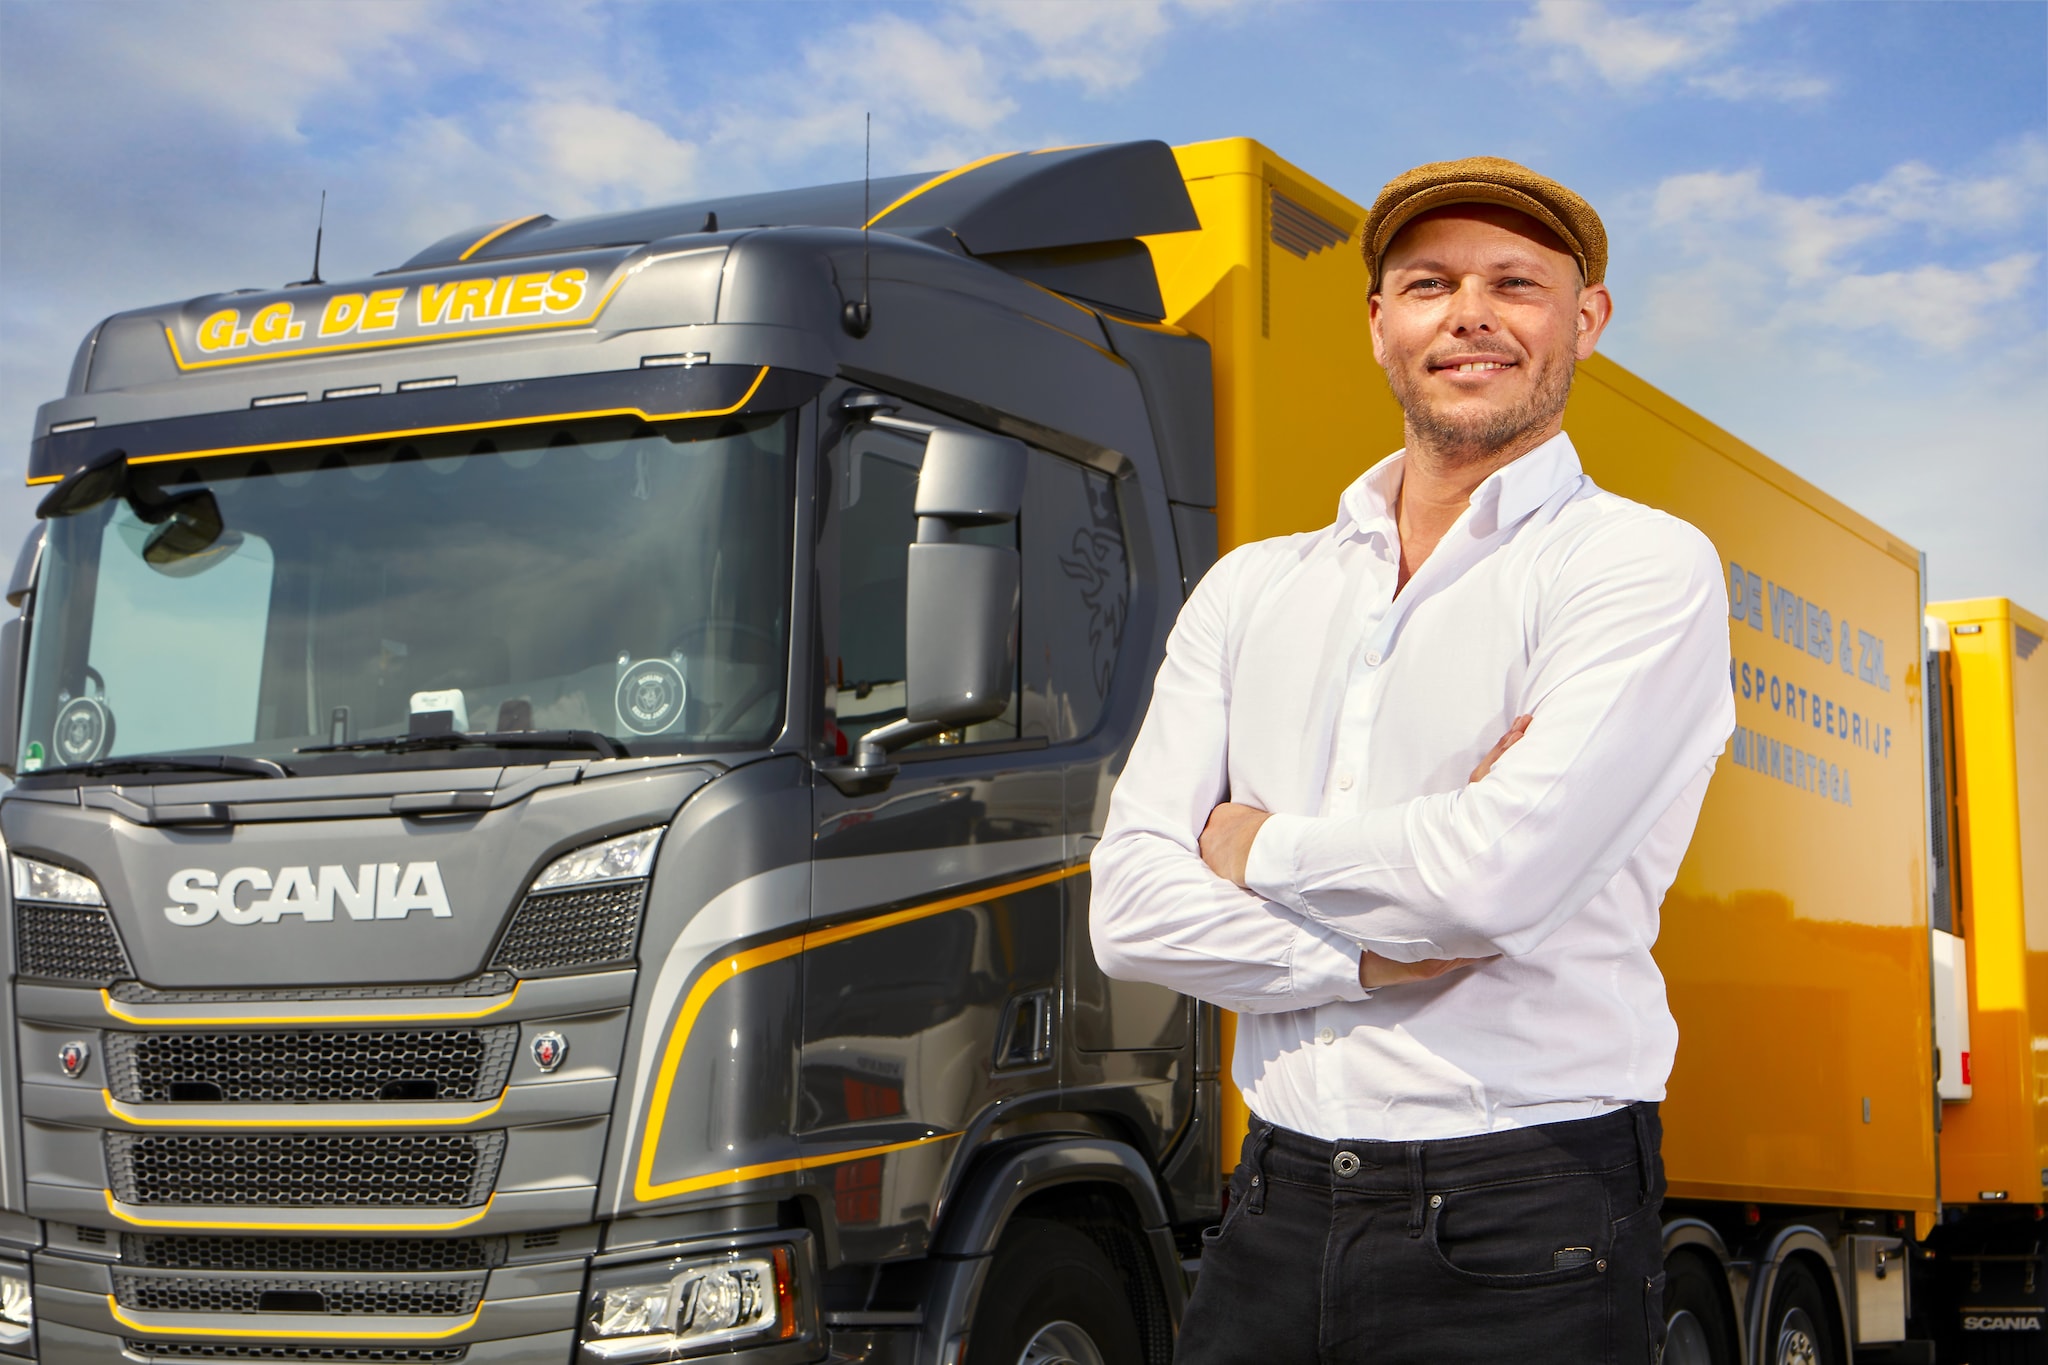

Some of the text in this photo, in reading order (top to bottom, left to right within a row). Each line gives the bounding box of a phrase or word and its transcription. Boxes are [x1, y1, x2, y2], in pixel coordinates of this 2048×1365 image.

[197, 268, 588, 352] G.G. DE VRIES
[1730, 561, 1763, 632] DE
[1768, 581, 1832, 664] VRIES
[1839, 619, 1854, 676] &
[1730, 657, 1892, 760] NSPORTBEDRIJF
[163, 860, 453, 927] SCANIA
[1964, 1317, 2040, 1330] SCANIA
